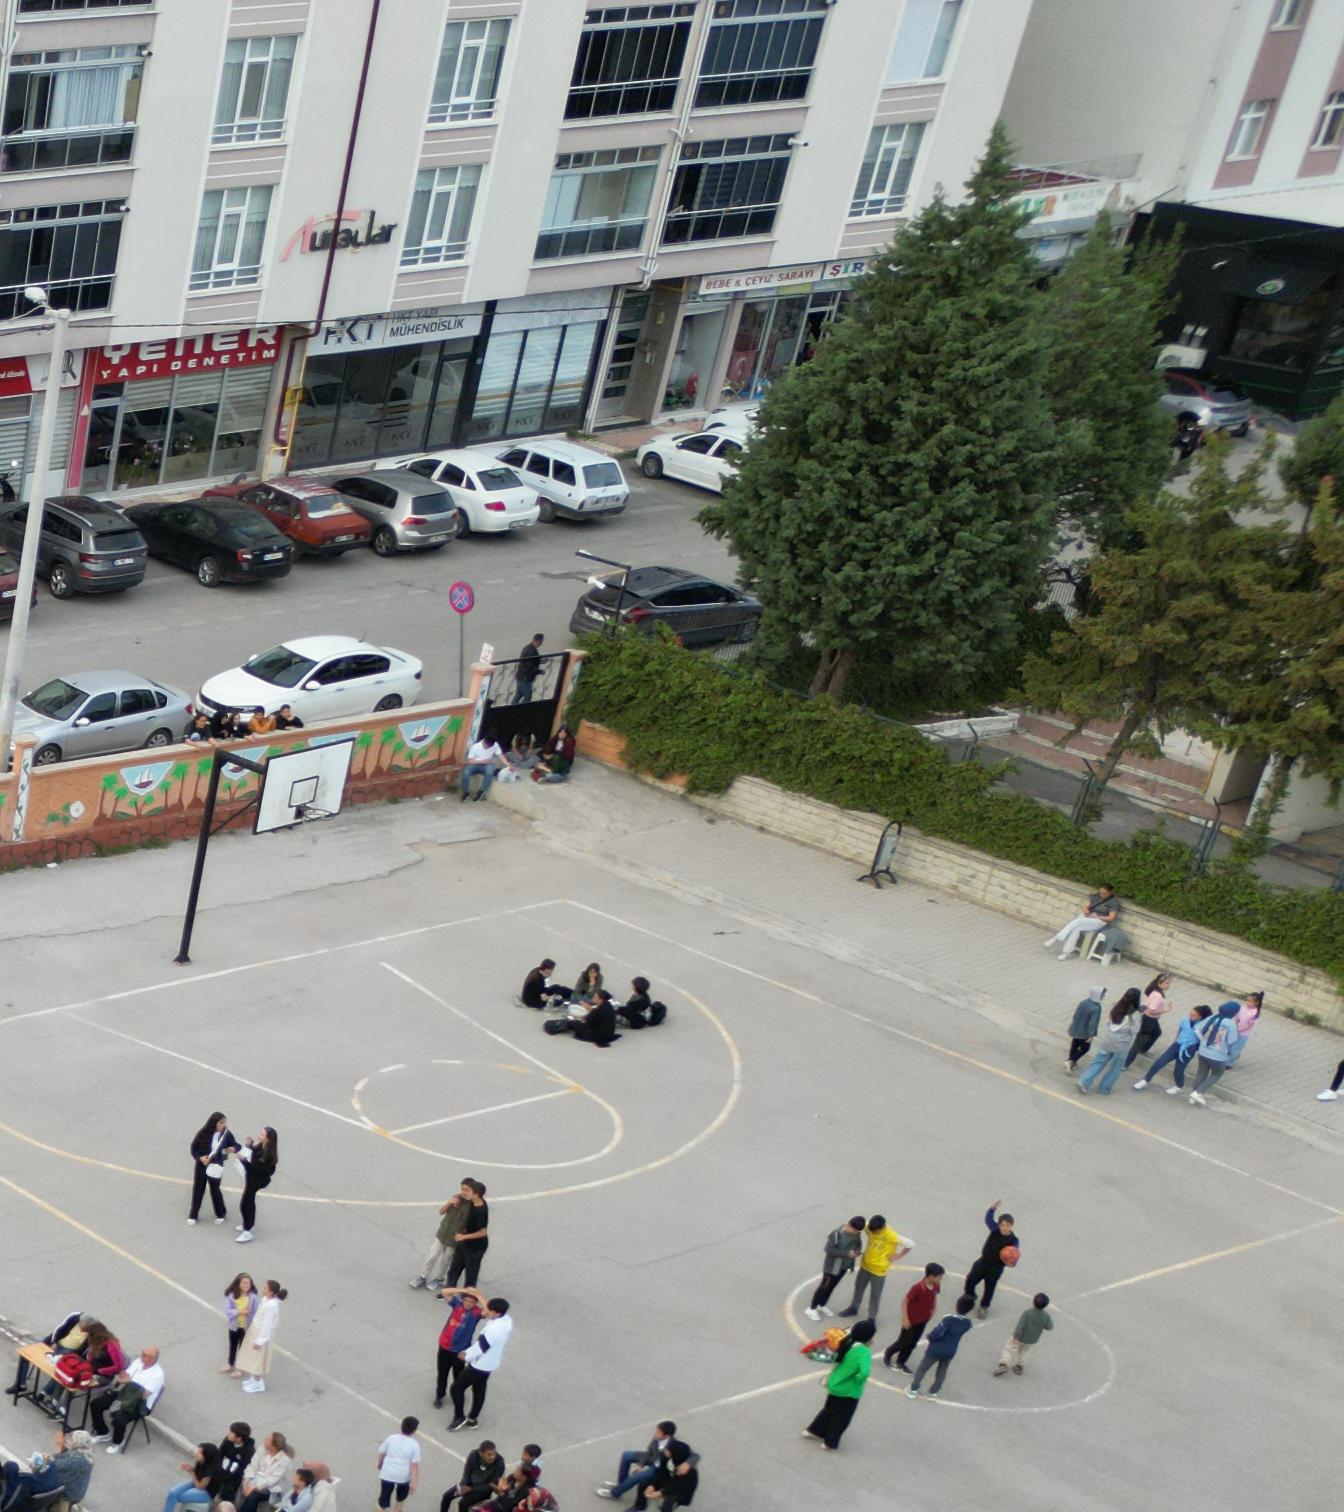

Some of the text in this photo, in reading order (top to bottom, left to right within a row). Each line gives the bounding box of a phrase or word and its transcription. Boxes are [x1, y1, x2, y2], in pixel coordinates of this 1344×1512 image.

[705, 277, 732, 290] BEBE
[777, 269, 815, 282] SARAYI
[389, 316, 465, 338] MÜHENDİSLİK
[100, 348, 276, 379] YAPI DENETİM
